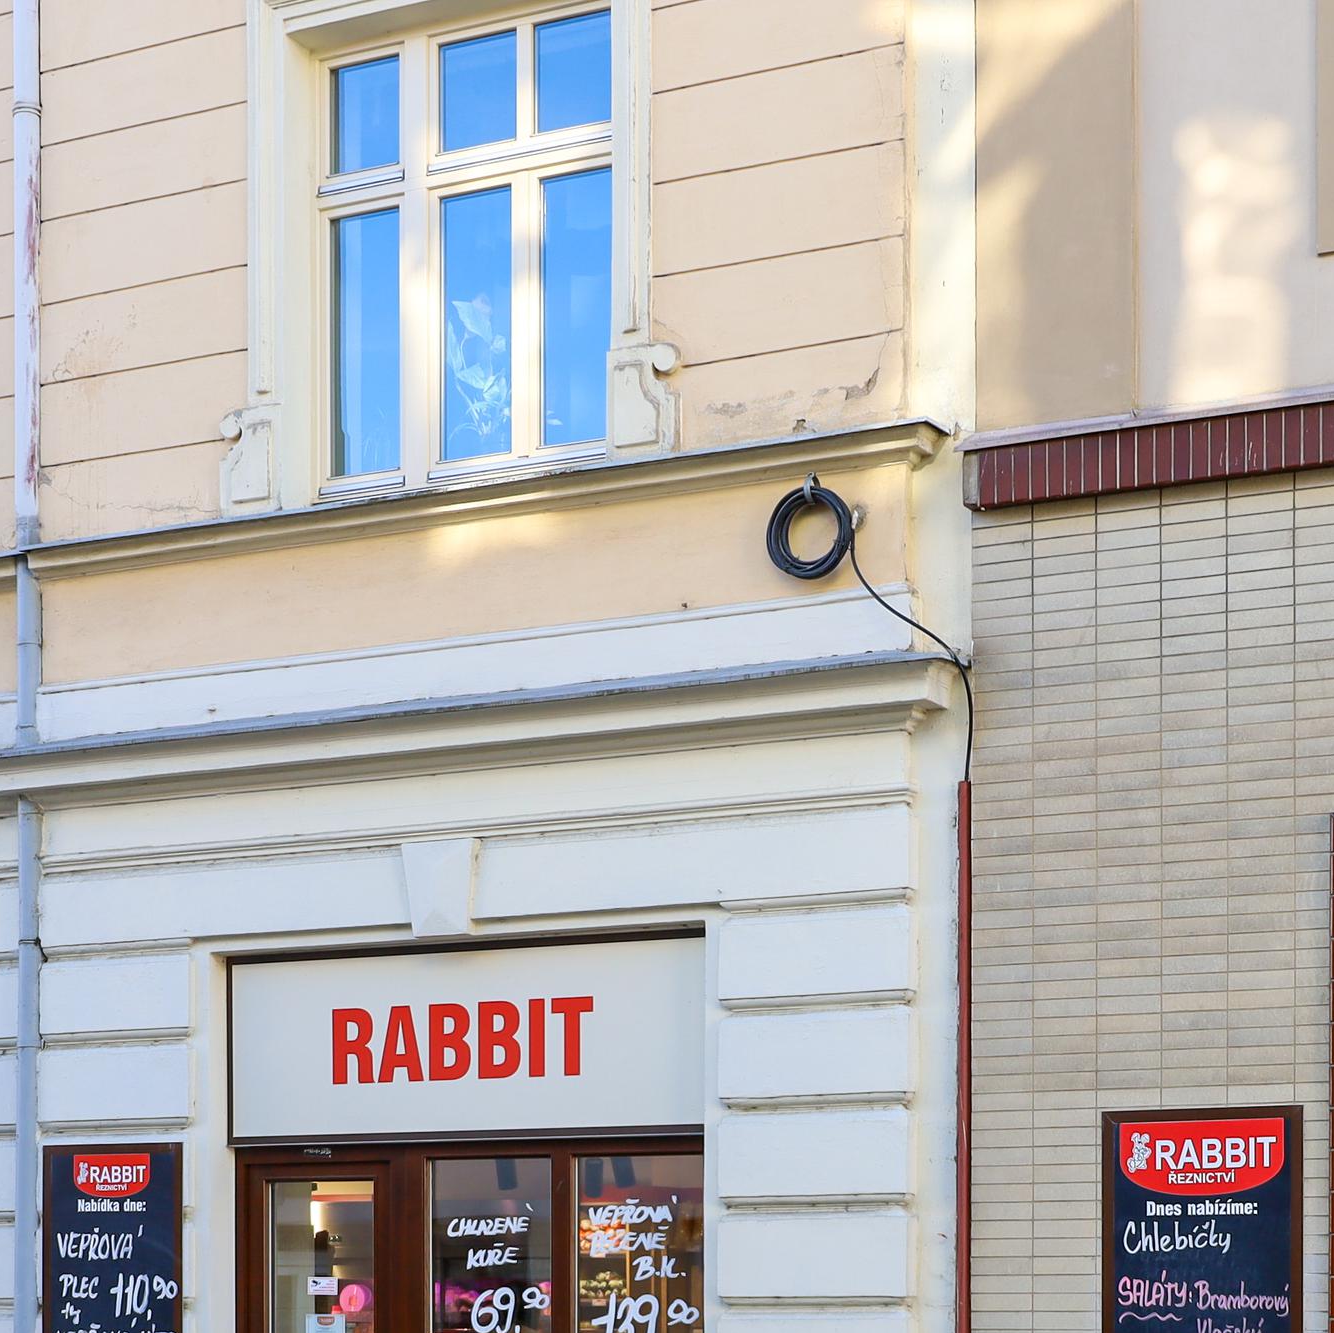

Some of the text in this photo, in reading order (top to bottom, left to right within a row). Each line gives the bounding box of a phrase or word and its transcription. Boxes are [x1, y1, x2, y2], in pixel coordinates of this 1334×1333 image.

[331, 996, 594, 1085] RABBIT
[1155, 1136, 1276, 1170] RABBIT
[90, 1165, 146, 1183] RABBIT
[95, 1183, 128, 1191] ŘEZNICTVÍ
[1168, 1169, 1235, 1184] ŘEZNICTVÍ
[77, 1198, 147, 1213] Nabídka dne:
[1146, 1199, 1258, 1216] Dnes nabízíme:
[57, 1224, 144, 1261] VEPŘOVÁ
[1123, 1219, 1231, 1254] Chlebíčky
[467, 1243, 519, 1270] KUŘE
[59, 1274, 100, 1299] PLEC
[1194, 1280, 1289, 1317] Bramborový
